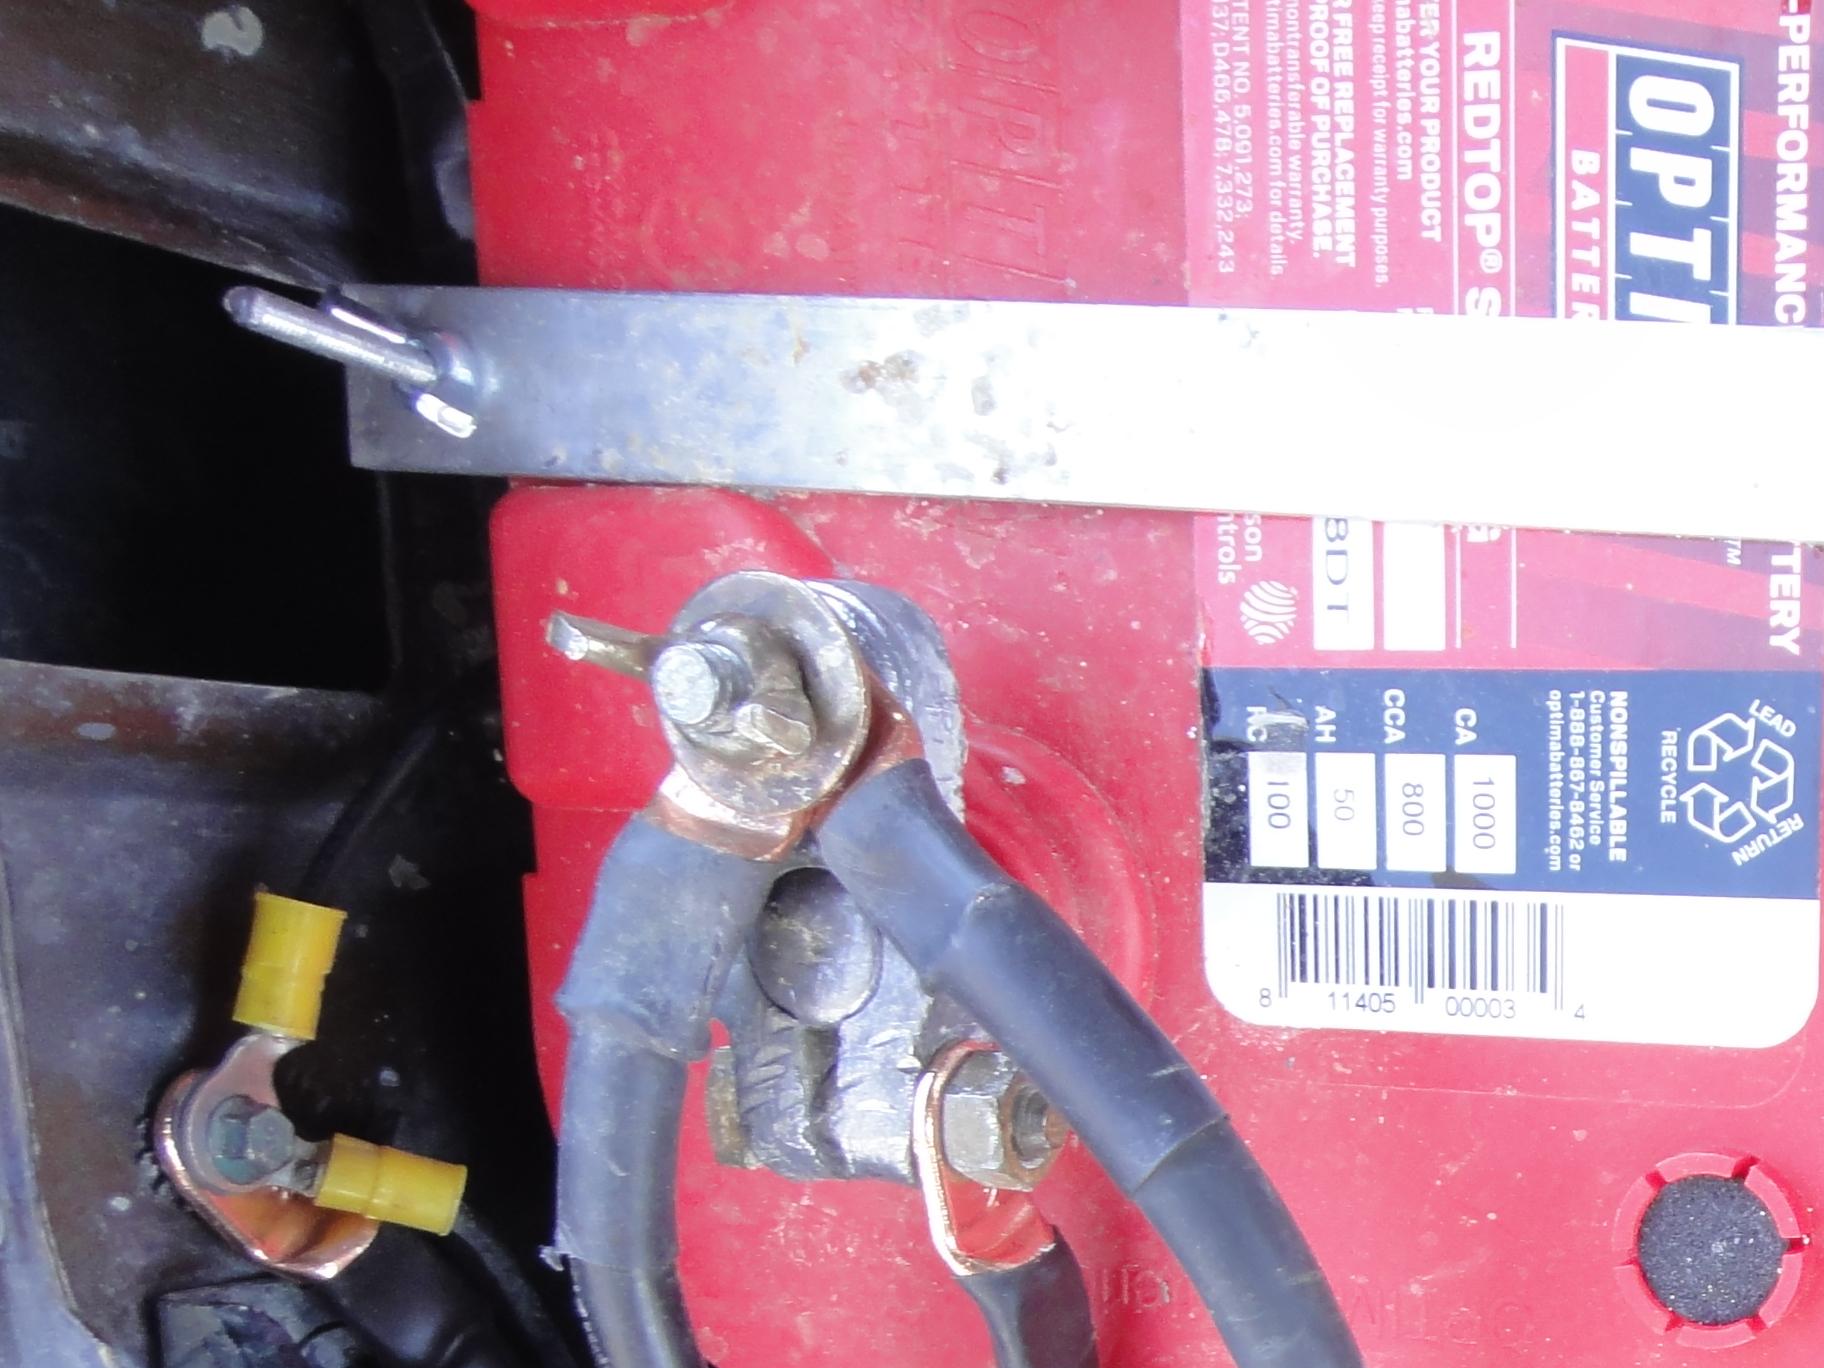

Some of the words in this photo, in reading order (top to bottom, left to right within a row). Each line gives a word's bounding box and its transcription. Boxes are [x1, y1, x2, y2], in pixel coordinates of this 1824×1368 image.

[1333, 13, 1354, 77] FREE
[1369, 37, 1390, 97] receipt
[1231, 61, 1251, 99] NO.
[1310, 77, 1331, 110] OF
[1420, 42, 1440, 114] YOUR
[1371, 101, 1391, 125] for
[1268, 180, 1286, 206] for
[1311, 114, 1333, 260] PURCHASE.
[1334, 81, 1356, 268] REPLACEMENT
[1370, 128, 1391, 203] warranty
[1420, 119, 1442, 243] PRODUCT
[1370, 207, 1390, 288] purposes.
[1769, 539, 1802, 656] TERY
[1314, 705, 1337, 743] AH
[1383, 688, 1407, 745] CCA
[1454, 707, 1478, 746] CA
[1589, 690, 1607, 777] Customer
[1748, 698, 1797, 738] LEAD
[1546, 689, 1566, 872] optimabatteries.com
[1569, 690, 1586, 851] 1-888-867-8462
[1609, 690, 1629, 863] NONSPILLABLE
[1660, 729, 1678, 824] RECYCLE
[1267, 780, 1292, 830] 100
[1333, 788, 1356, 822] 50
[1402, 782, 1426, 837] 800
[1473, 776, 1497, 850] 1000
[1588, 779, 1606, 846] Service
[1568, 853, 1582, 872] or
[1731, 812, 1805, 867] RETURN
[1258, 987, 1272, 1008] 8
[1328, 991, 1397, 1014] 11405
[1445, 996, 1517, 1020] 00003
[1573, 1003, 1587, 1021] 4
